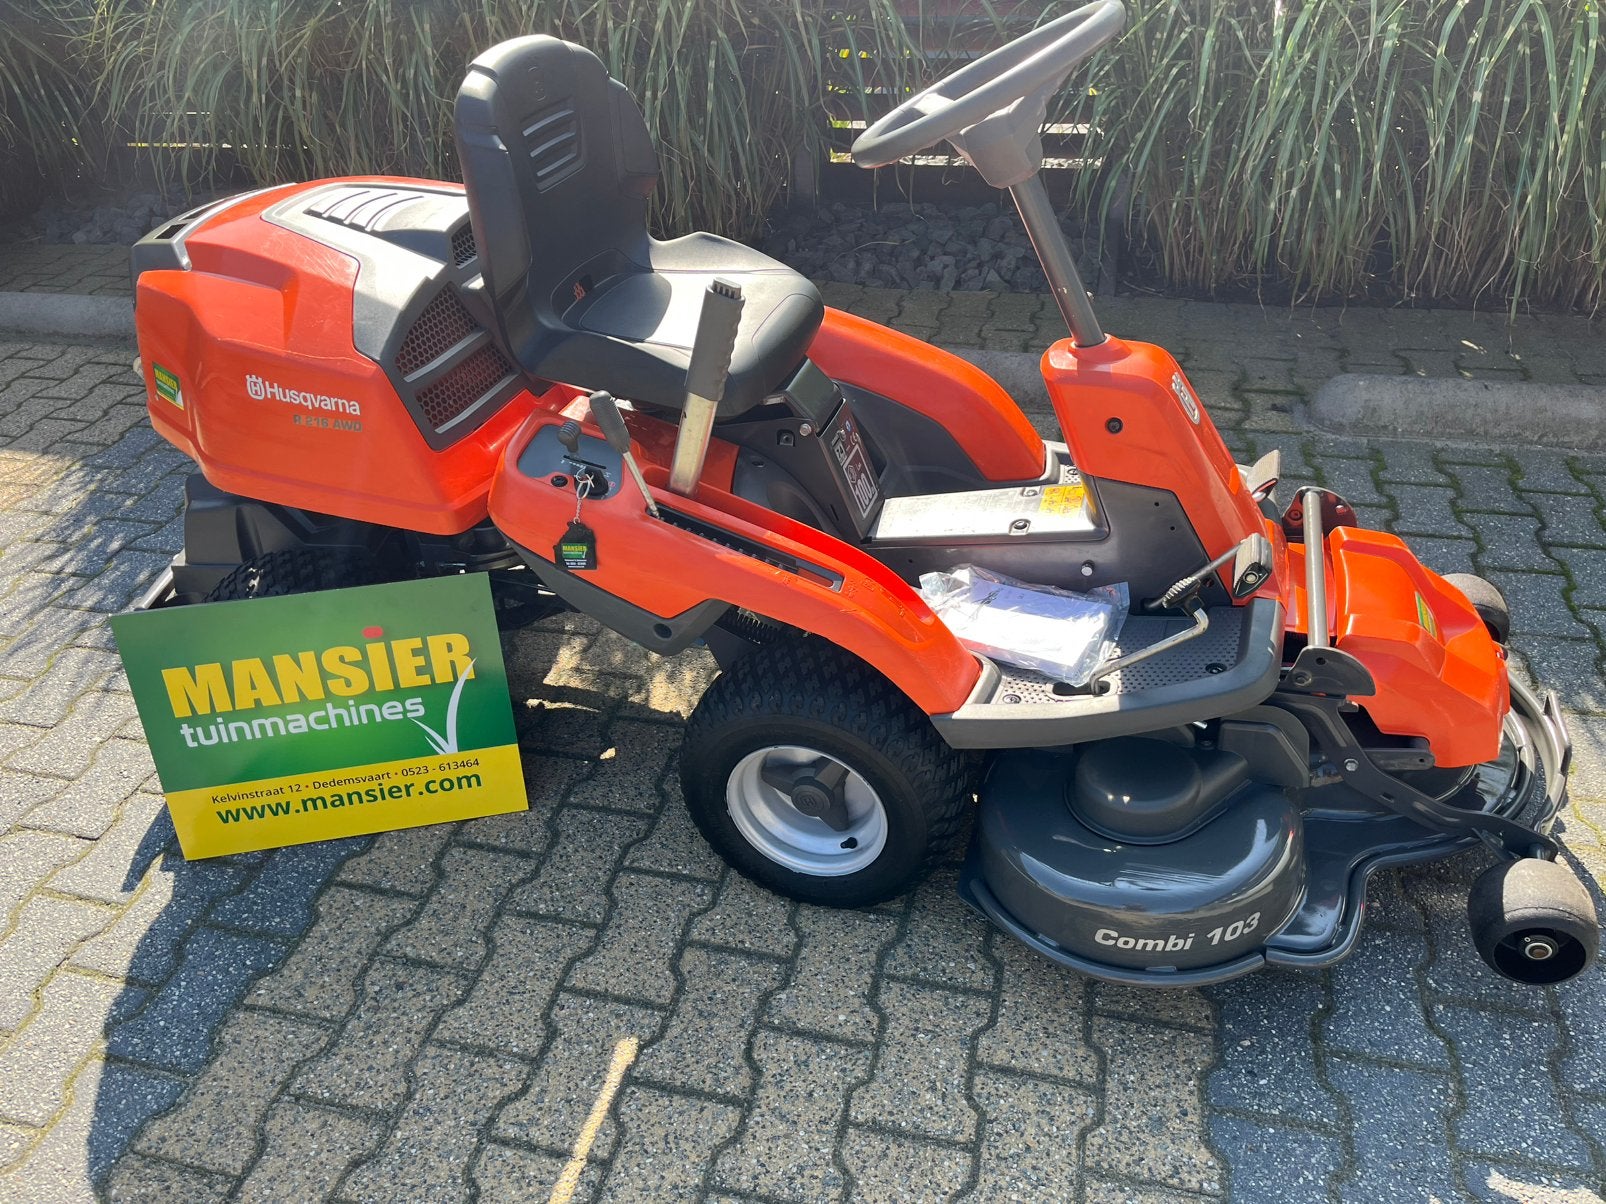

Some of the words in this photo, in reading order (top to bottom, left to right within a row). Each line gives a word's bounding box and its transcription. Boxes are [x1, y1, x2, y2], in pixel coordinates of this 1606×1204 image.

[265, 381, 361, 416] Husqvarna
[293, 414, 302, 425] R
[305, 416, 329, 428] 216
[333, 420, 363, 432] AWD
[161, 629, 475, 718] MANSIER
[180, 697, 425, 747] tuinmachines
[212, 787, 285, 804] Kelvinstraat
[288, 784, 302, 793] 12
[312, 771, 392, 790] Dedemsvaart
[401, 766, 429, 777] 0523
[439, 758, 480, 772] 613464
[216, 773, 482, 824] www.mansier.com
[1094, 928, 1195, 951] Combi
[1206, 912, 1261, 945] 103
